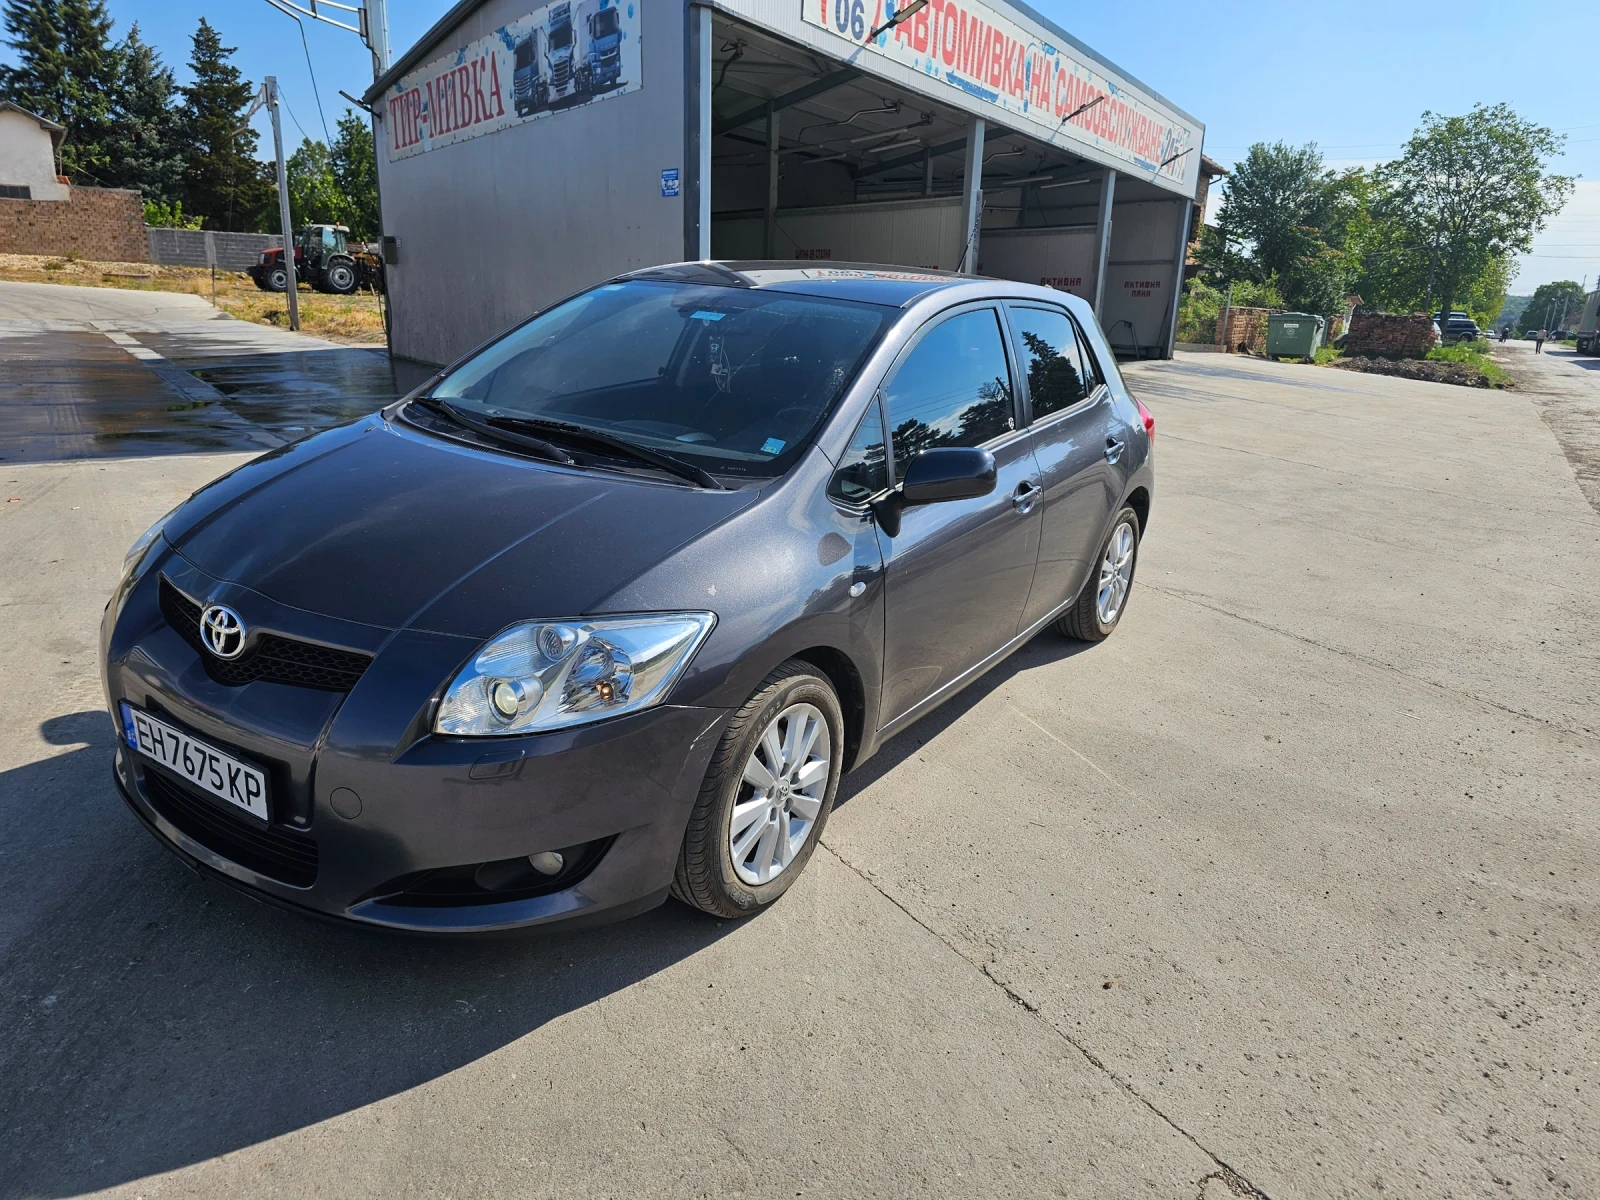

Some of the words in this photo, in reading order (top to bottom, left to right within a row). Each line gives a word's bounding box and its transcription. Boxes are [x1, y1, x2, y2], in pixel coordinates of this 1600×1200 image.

[389, 51, 505, 150] ТИР-МИВКА
[894, 0, 1026, 100] АВТОМИВКА
[1029, 52, 1051, 112] НА
[1055, 68, 1164, 163] САМООБСЛУЖВАНЕ
[1040, 277, 1082, 287] АКТИВНА
[1124, 281, 1161, 289] АКТИВНА
[1131, 290, 1151, 298] ПЯНА
[135, 715, 261, 807] EH7675KP
